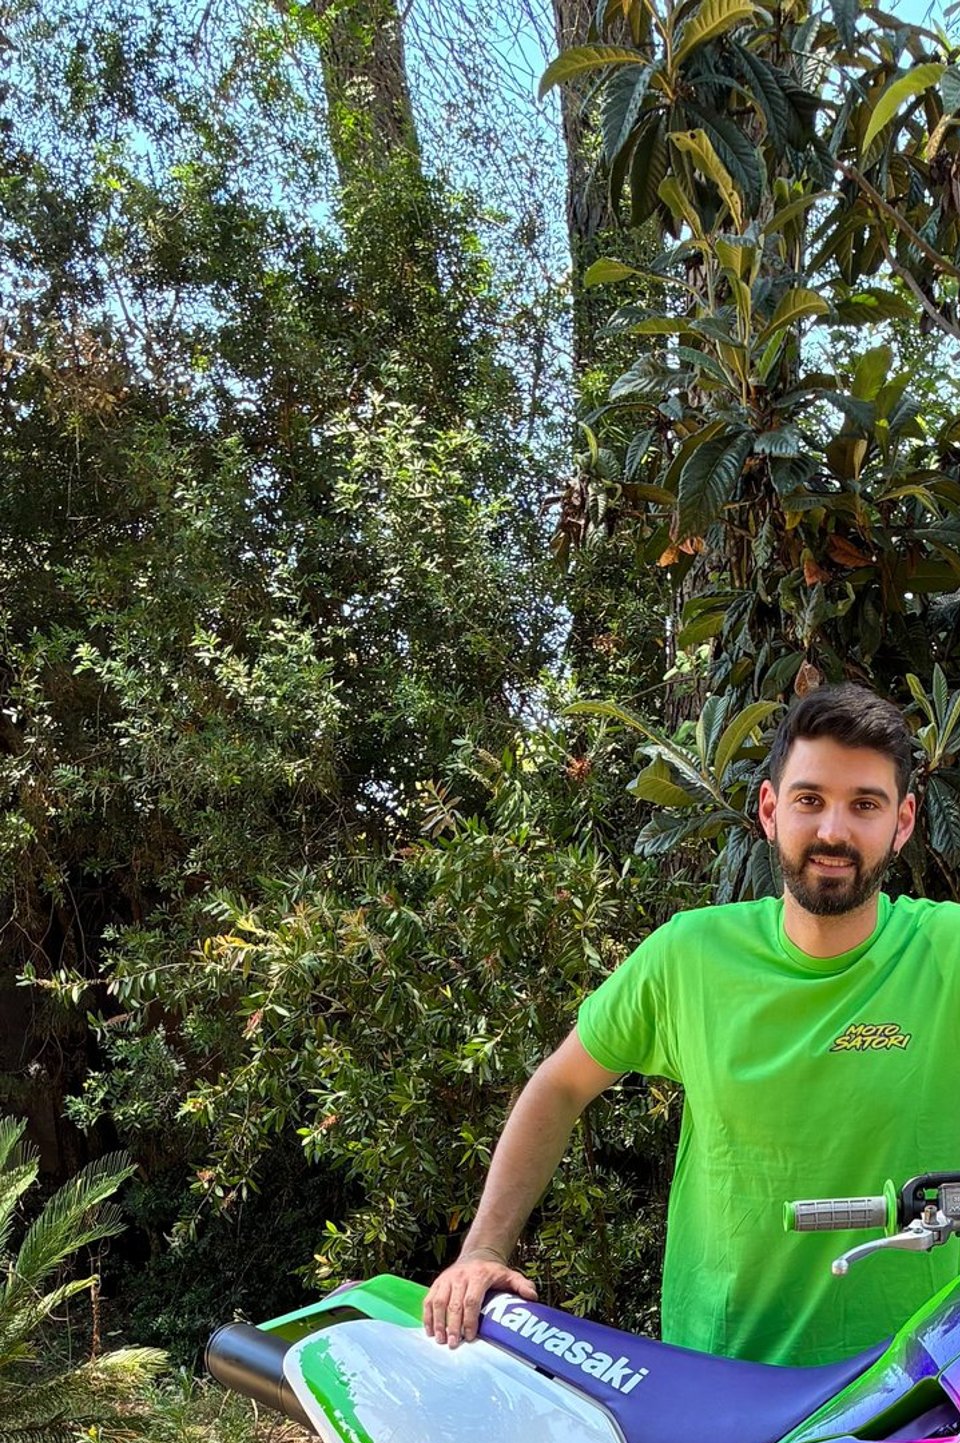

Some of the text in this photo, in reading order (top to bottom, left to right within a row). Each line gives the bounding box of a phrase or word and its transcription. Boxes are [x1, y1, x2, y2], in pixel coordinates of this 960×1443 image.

[846, 1023, 901, 1037] MOTO
[830, 1033, 911, 1052] SATORI
[481, 1293, 650, 1395] Kawasaki
